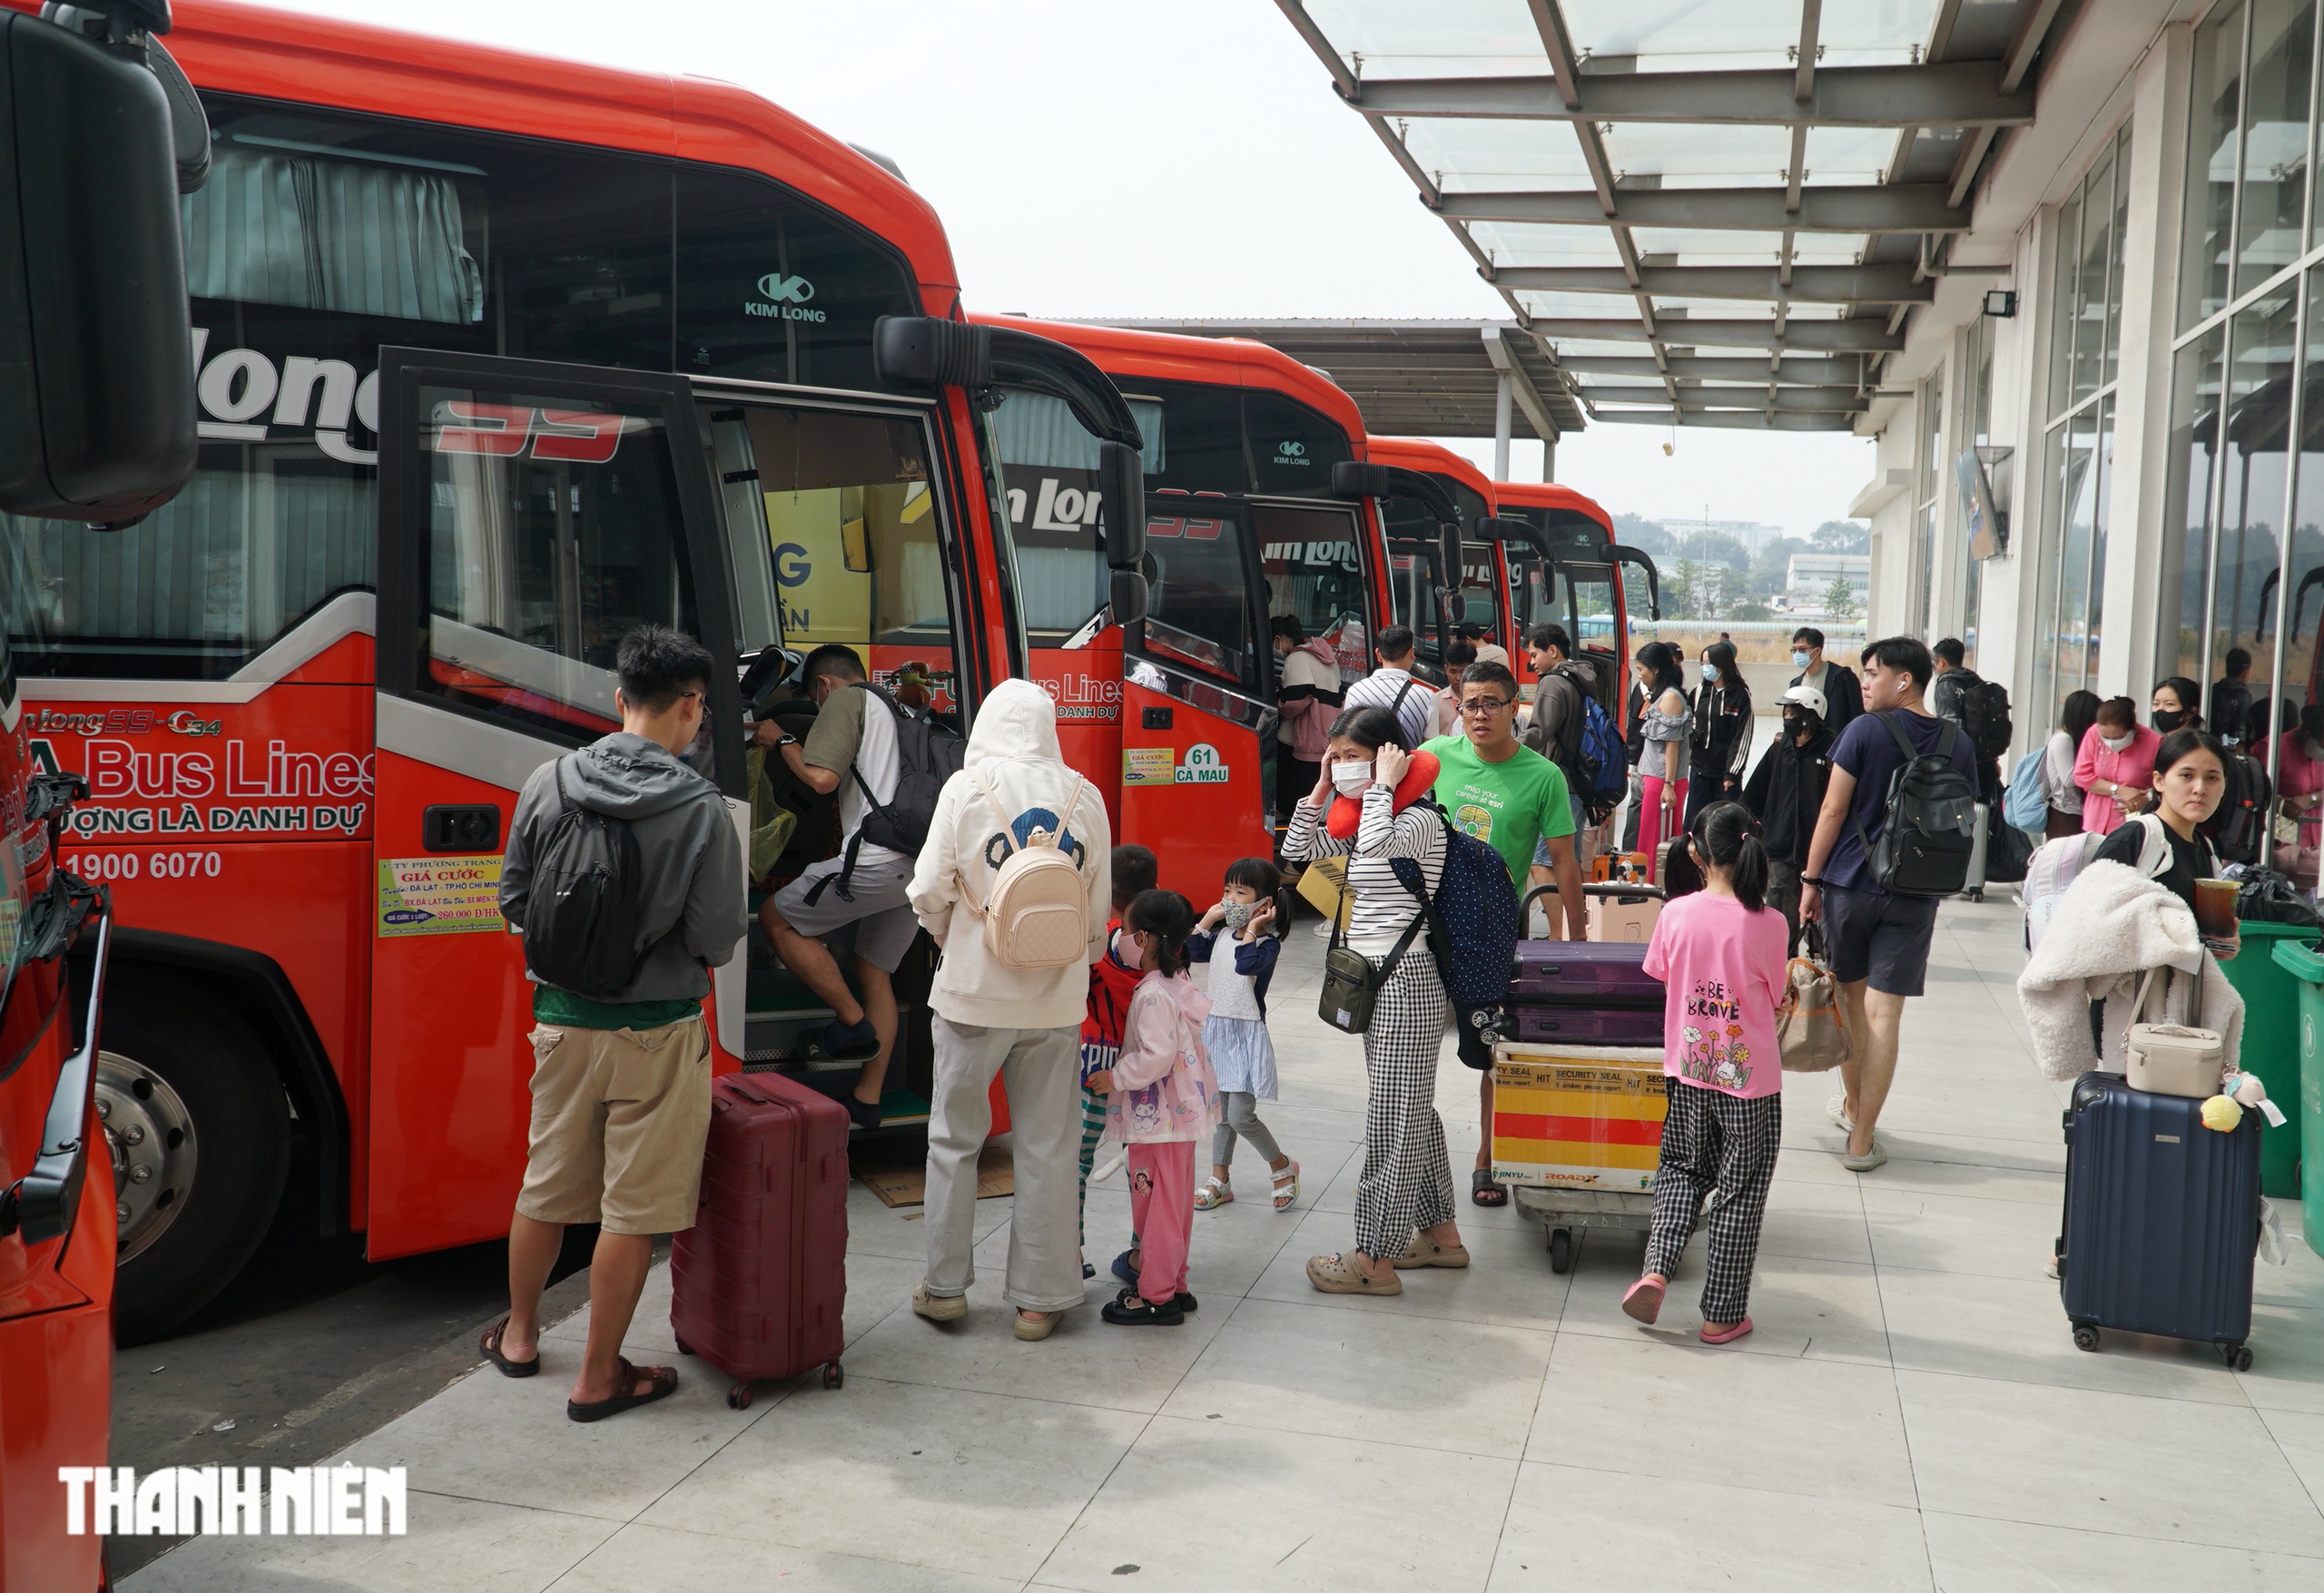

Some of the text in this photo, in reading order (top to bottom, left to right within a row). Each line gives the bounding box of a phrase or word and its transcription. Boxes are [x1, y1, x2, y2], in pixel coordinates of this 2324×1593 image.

[745, 301, 826, 323] KIM LONG
[1274, 457, 1310, 467] KIM LONG
[1057, 705, 1118, 721] DANH DỰ
[1192, 749, 1211, 765] 61
[84, 739, 215, 799] Bus
[1177, 767, 1227, 782] CÀ MAU
[1455, 790, 1480, 801] career
[1488, 799, 1504, 810] esri
[1464, 784, 1498, 800] map your
[158, 802, 205, 833] LÀ
[209, 806, 308, 832] DANH
[312, 802, 366, 835] DỰ
[66, 851, 222, 880] 1900 6070
[412, 860, 460, 869] PHƯƠNG
[401, 869, 484, 882] GIÁ CƯỚC
[423, 882, 438, 893] LẠT
[438, 910, 471, 920] 260.000
[1708, 981, 1724, 1000] BE
[1511, 1067, 1531, 1076] SEAL
[1537, 1074, 1551, 1083] HIT
[1556, 1070, 1597, 1079] SECURITY
[1600, 1073, 1622, 1081] SEAL
[1627, 1079, 1640, 1088] HIT
[1498, 1171, 1524, 1179] JINYU
[1545, 1173, 1600, 1185] ROADX
